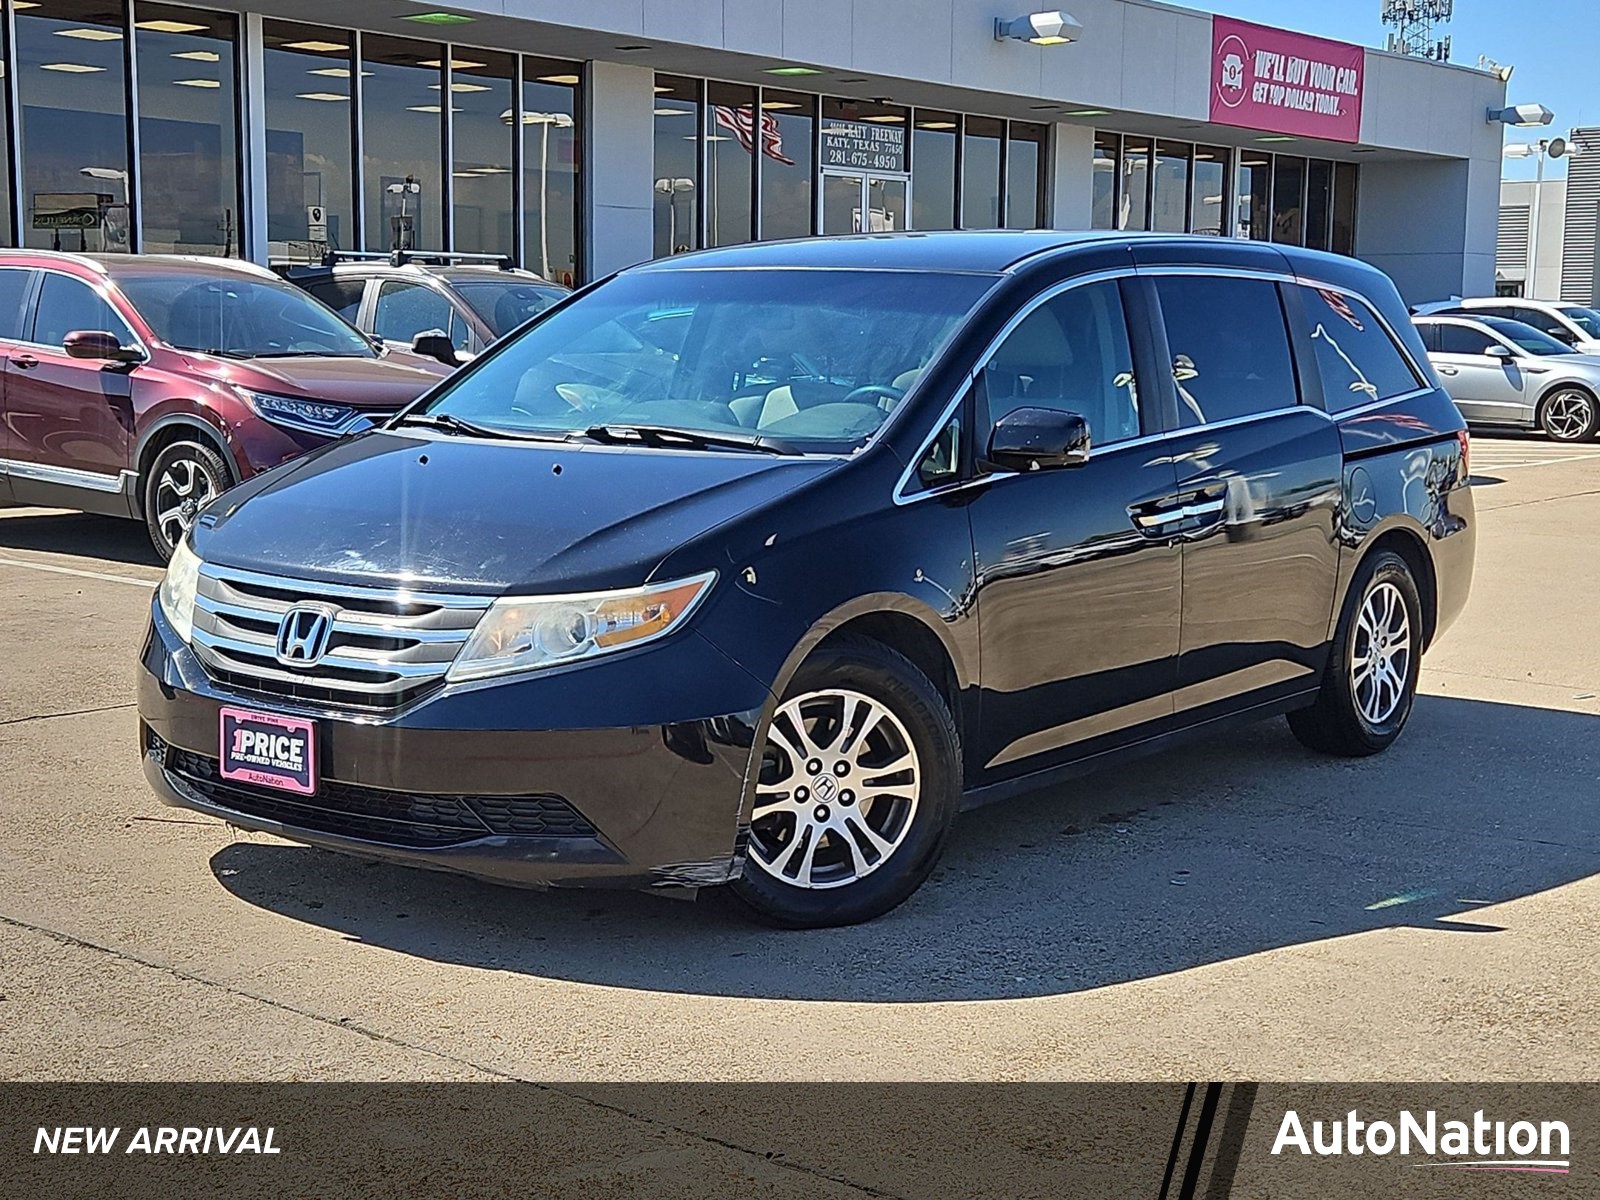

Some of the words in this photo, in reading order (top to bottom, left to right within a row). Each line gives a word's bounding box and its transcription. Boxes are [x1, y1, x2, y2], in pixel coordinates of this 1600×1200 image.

[1254, 50, 1285, 82] WE'LL
[1286, 56, 1310, 86] BUY
[1310, 61, 1336, 92] YOUR
[1336, 67, 1358, 96] CAR.
[1252, 81, 1270, 104] GET
[1269, 84, 1285, 107] TOP
[1284, 87, 1314, 112] DOLLAR
[853, 139, 880, 152] TEXAS
[871, 127, 904, 144] FREEWAY
[829, 149, 896, 169] 281-675-4950
[230, 751, 270, 766] PRE-OWNED
[271, 758, 303, 772] VEHICLES
[248, 772, 284, 787] AutoNation
